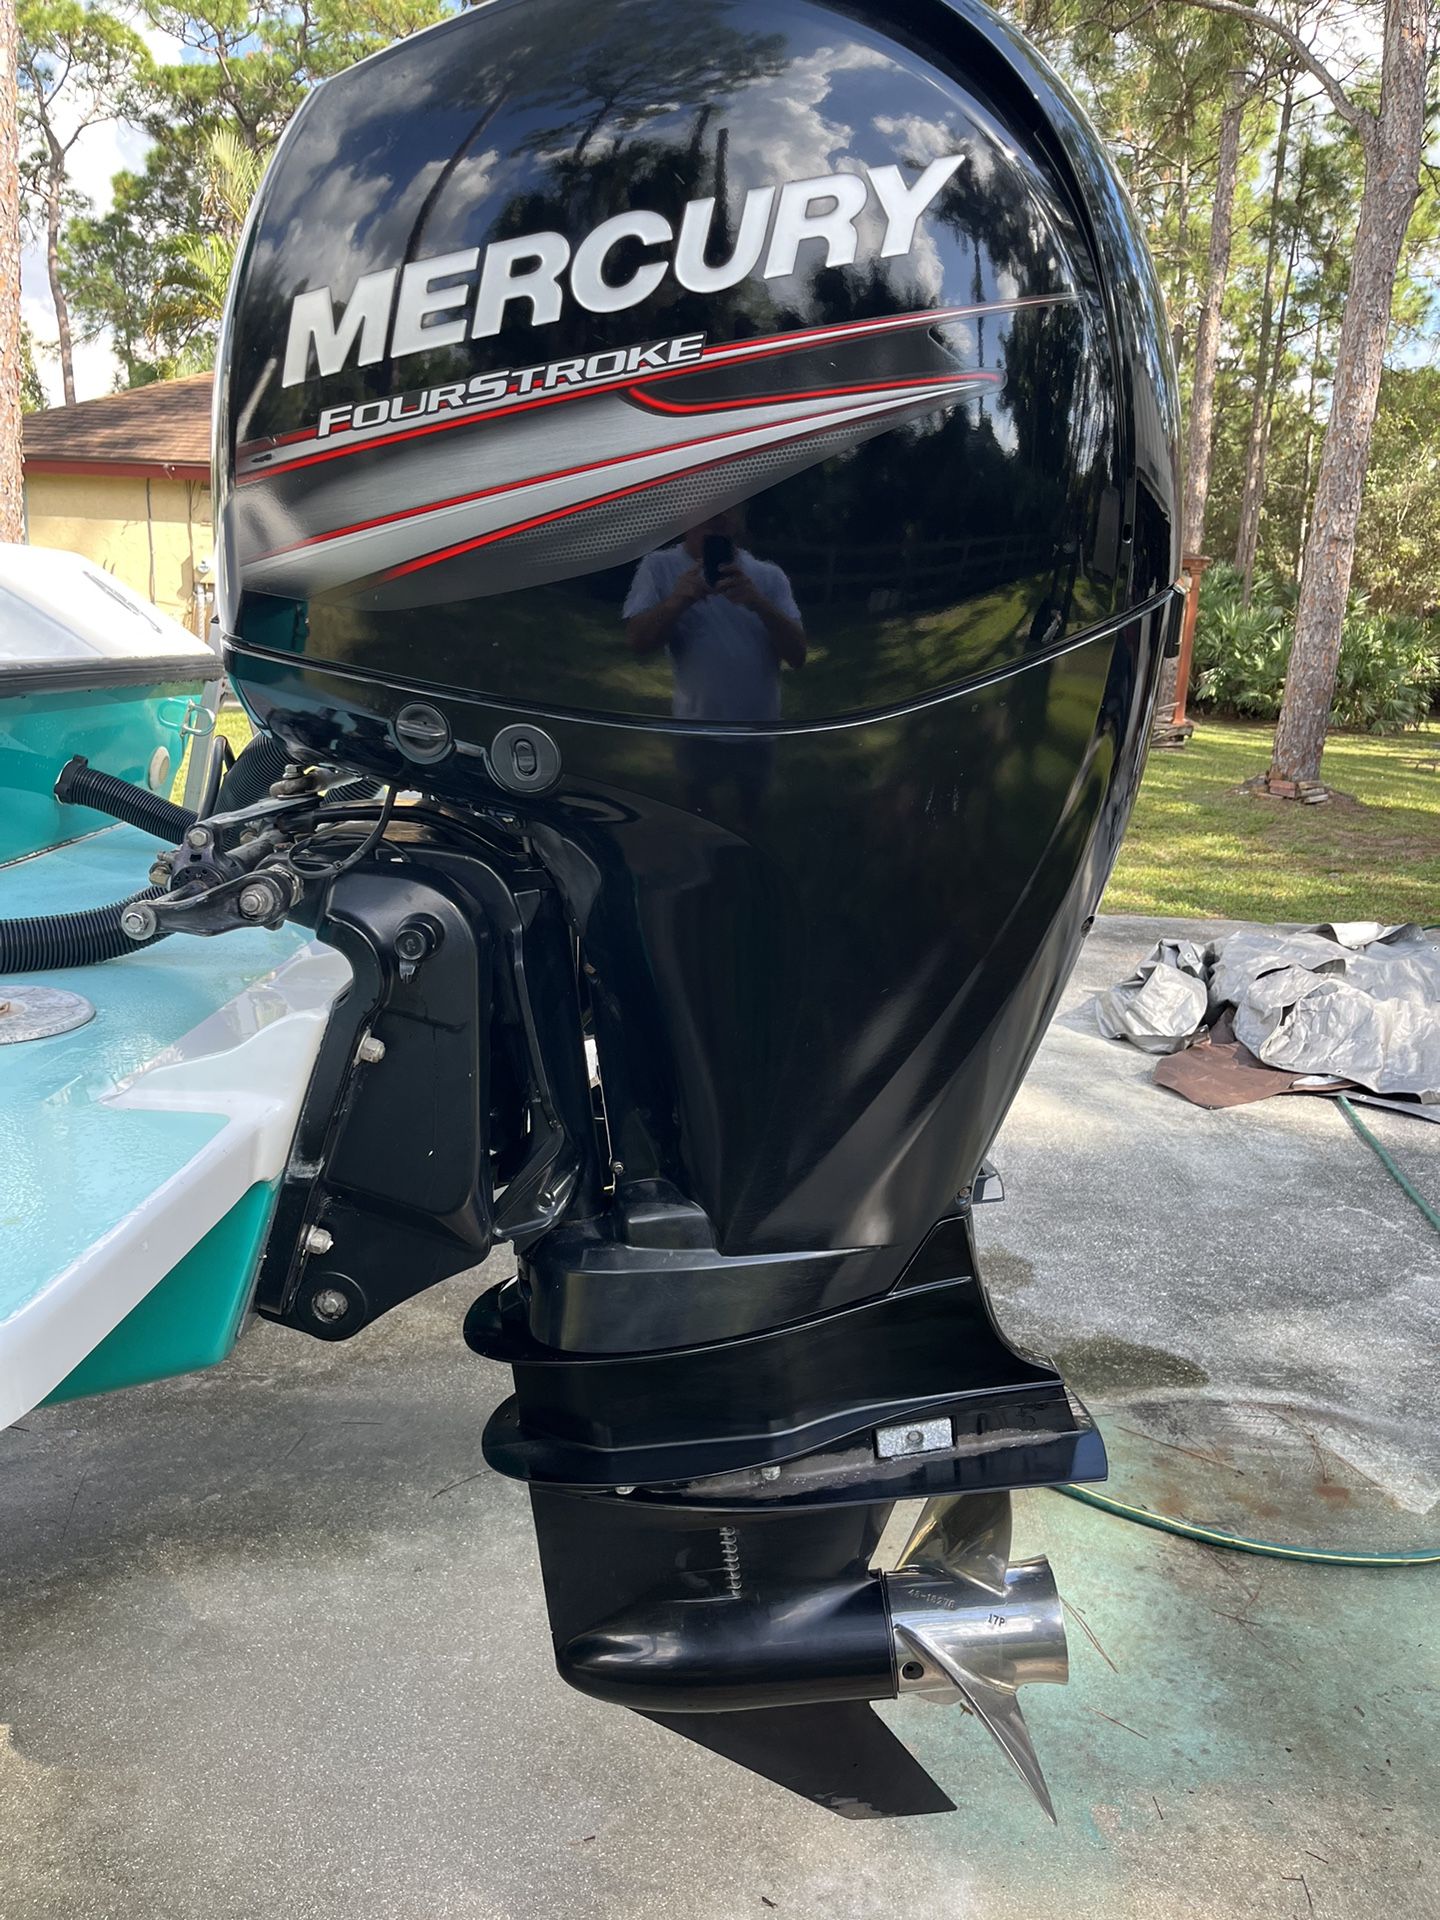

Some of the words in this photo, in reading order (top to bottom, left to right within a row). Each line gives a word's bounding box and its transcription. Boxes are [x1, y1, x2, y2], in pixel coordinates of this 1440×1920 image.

[282, 154, 967, 389] MERCURY
[317, 333, 706, 438] FOURSTROKE
[987, 1613, 1006, 1627] 17P
